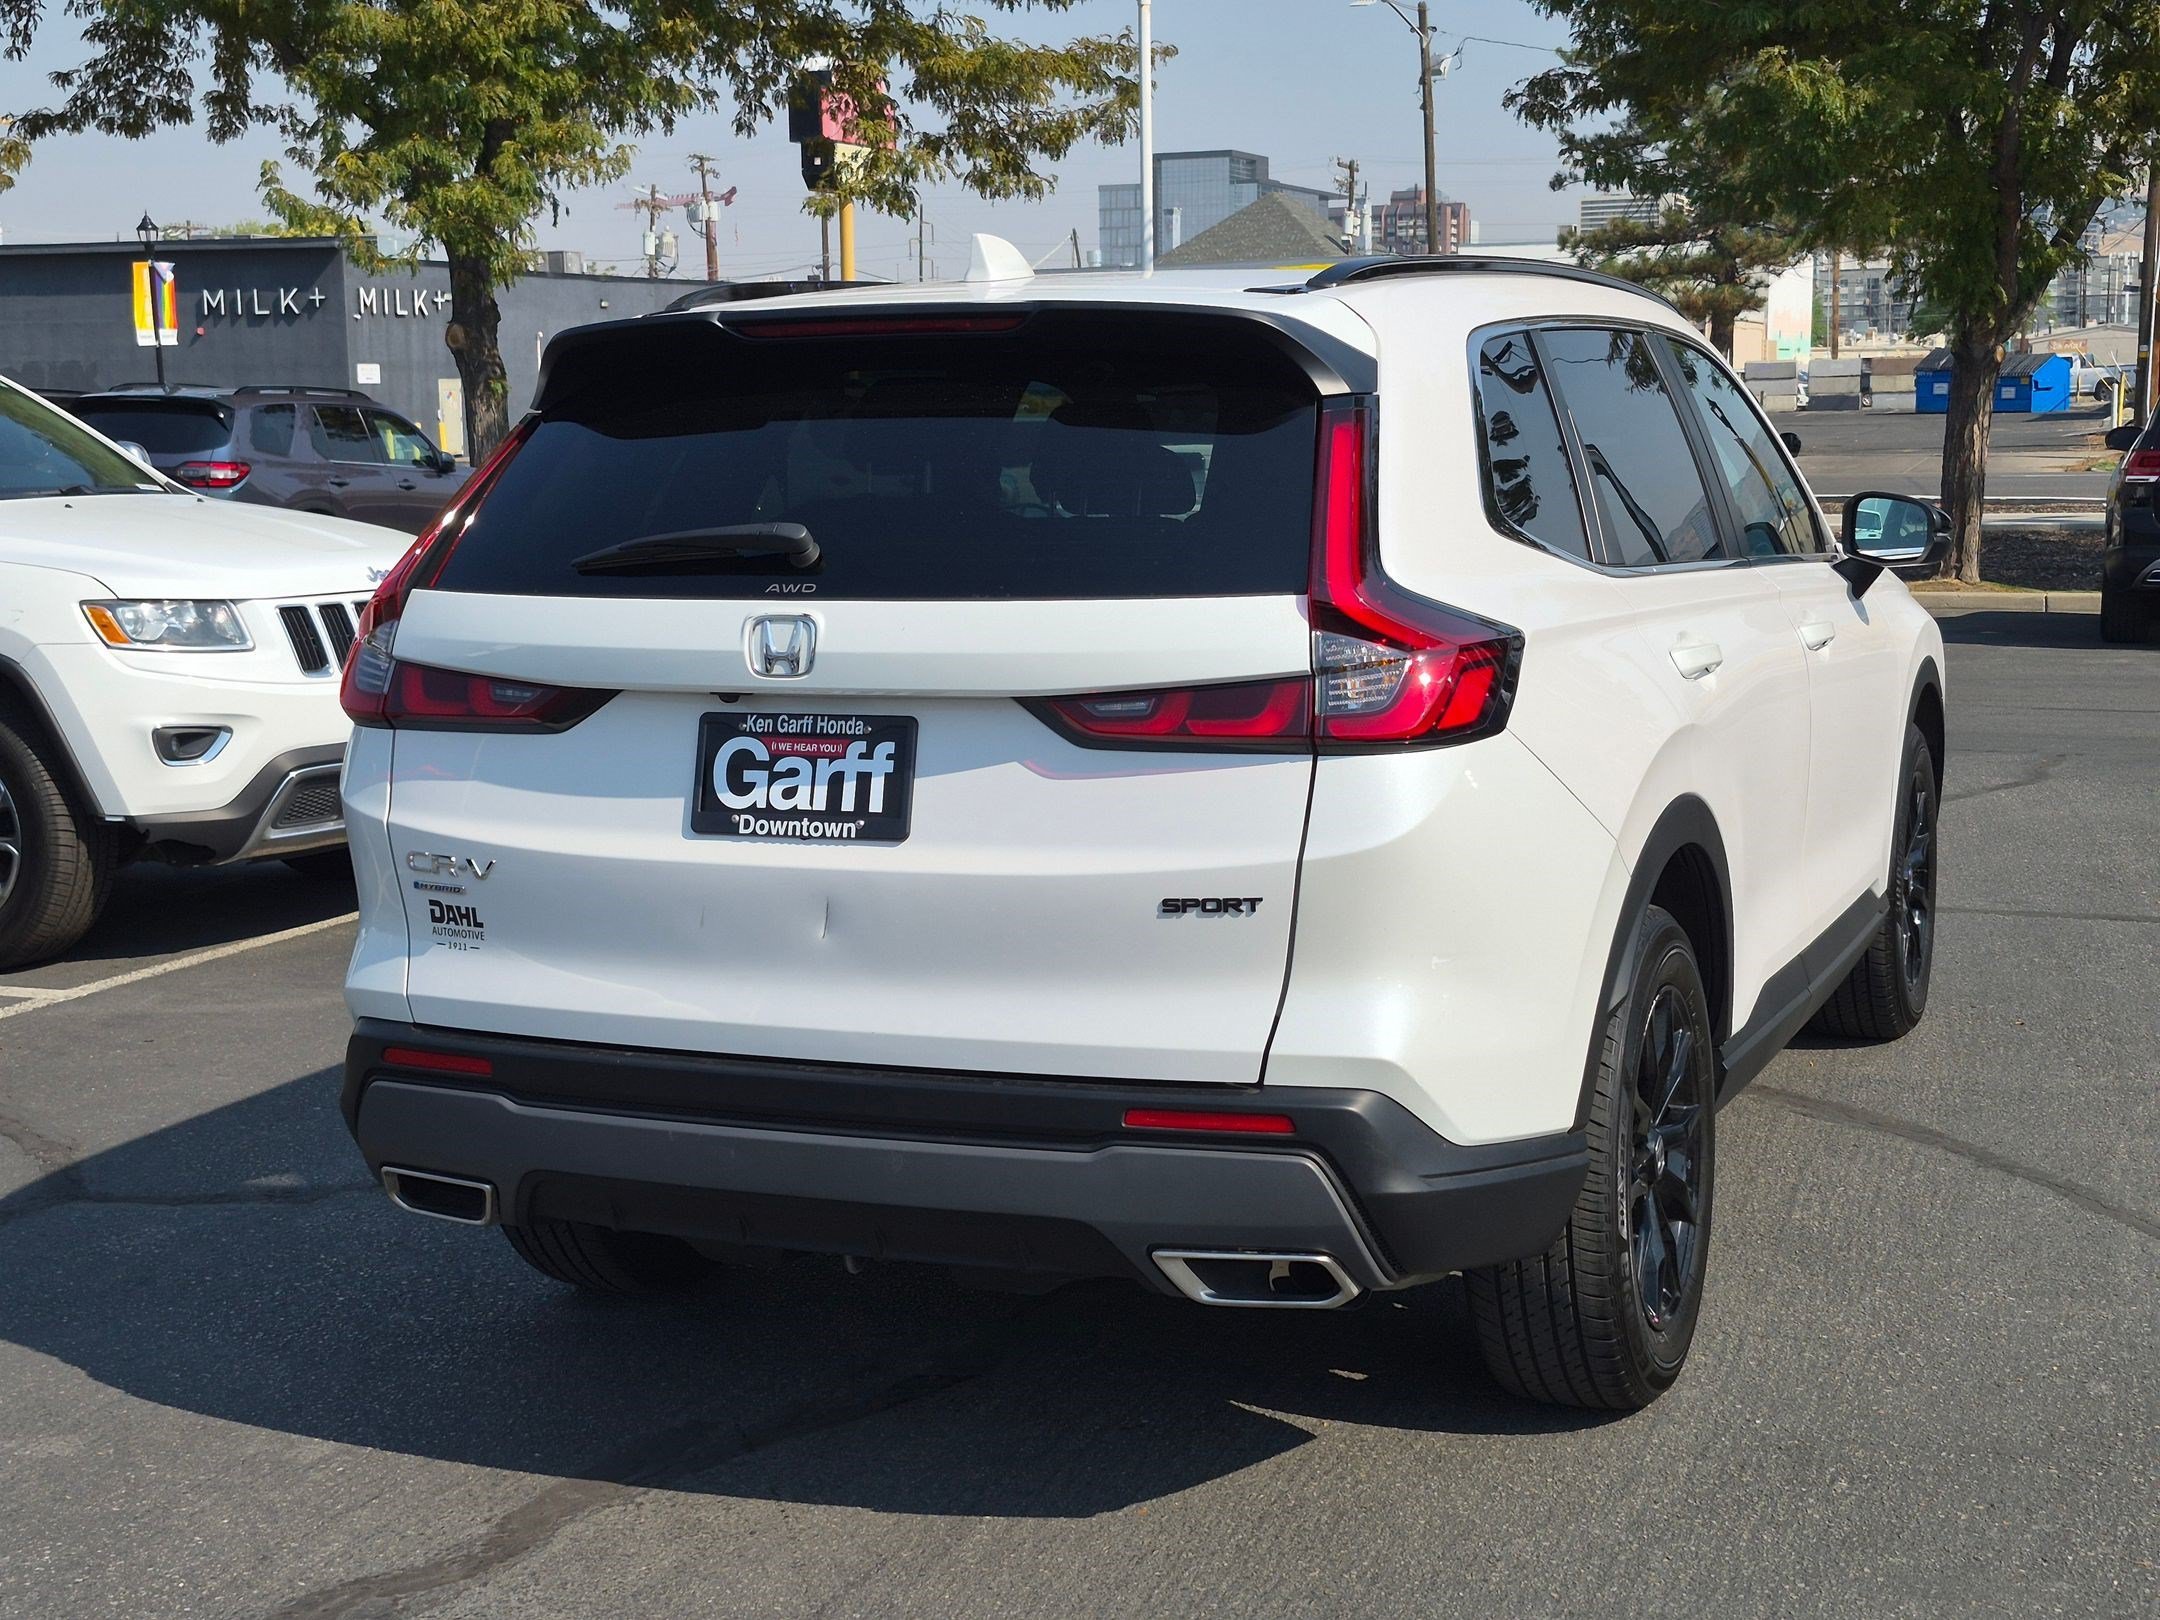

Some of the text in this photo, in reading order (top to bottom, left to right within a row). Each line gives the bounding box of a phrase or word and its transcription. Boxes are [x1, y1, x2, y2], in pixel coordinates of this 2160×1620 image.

[202, 287, 326, 316] MILK+
[358, 286, 446, 317] MILK+
[765, 583, 817, 593] AWD
[746, 714, 864, 735] Ken Garff Honda
[778, 742, 837, 753] WE HEAR YOU
[713, 736, 896, 813] Garff
[738, 814, 857, 838] Downtown
[407, 850, 496, 881] CR-V
[428, 899, 485, 929] DAHL
[1161, 897, 1263, 914] SPORT
[431, 926, 486, 941] AUTOMOTIVE
